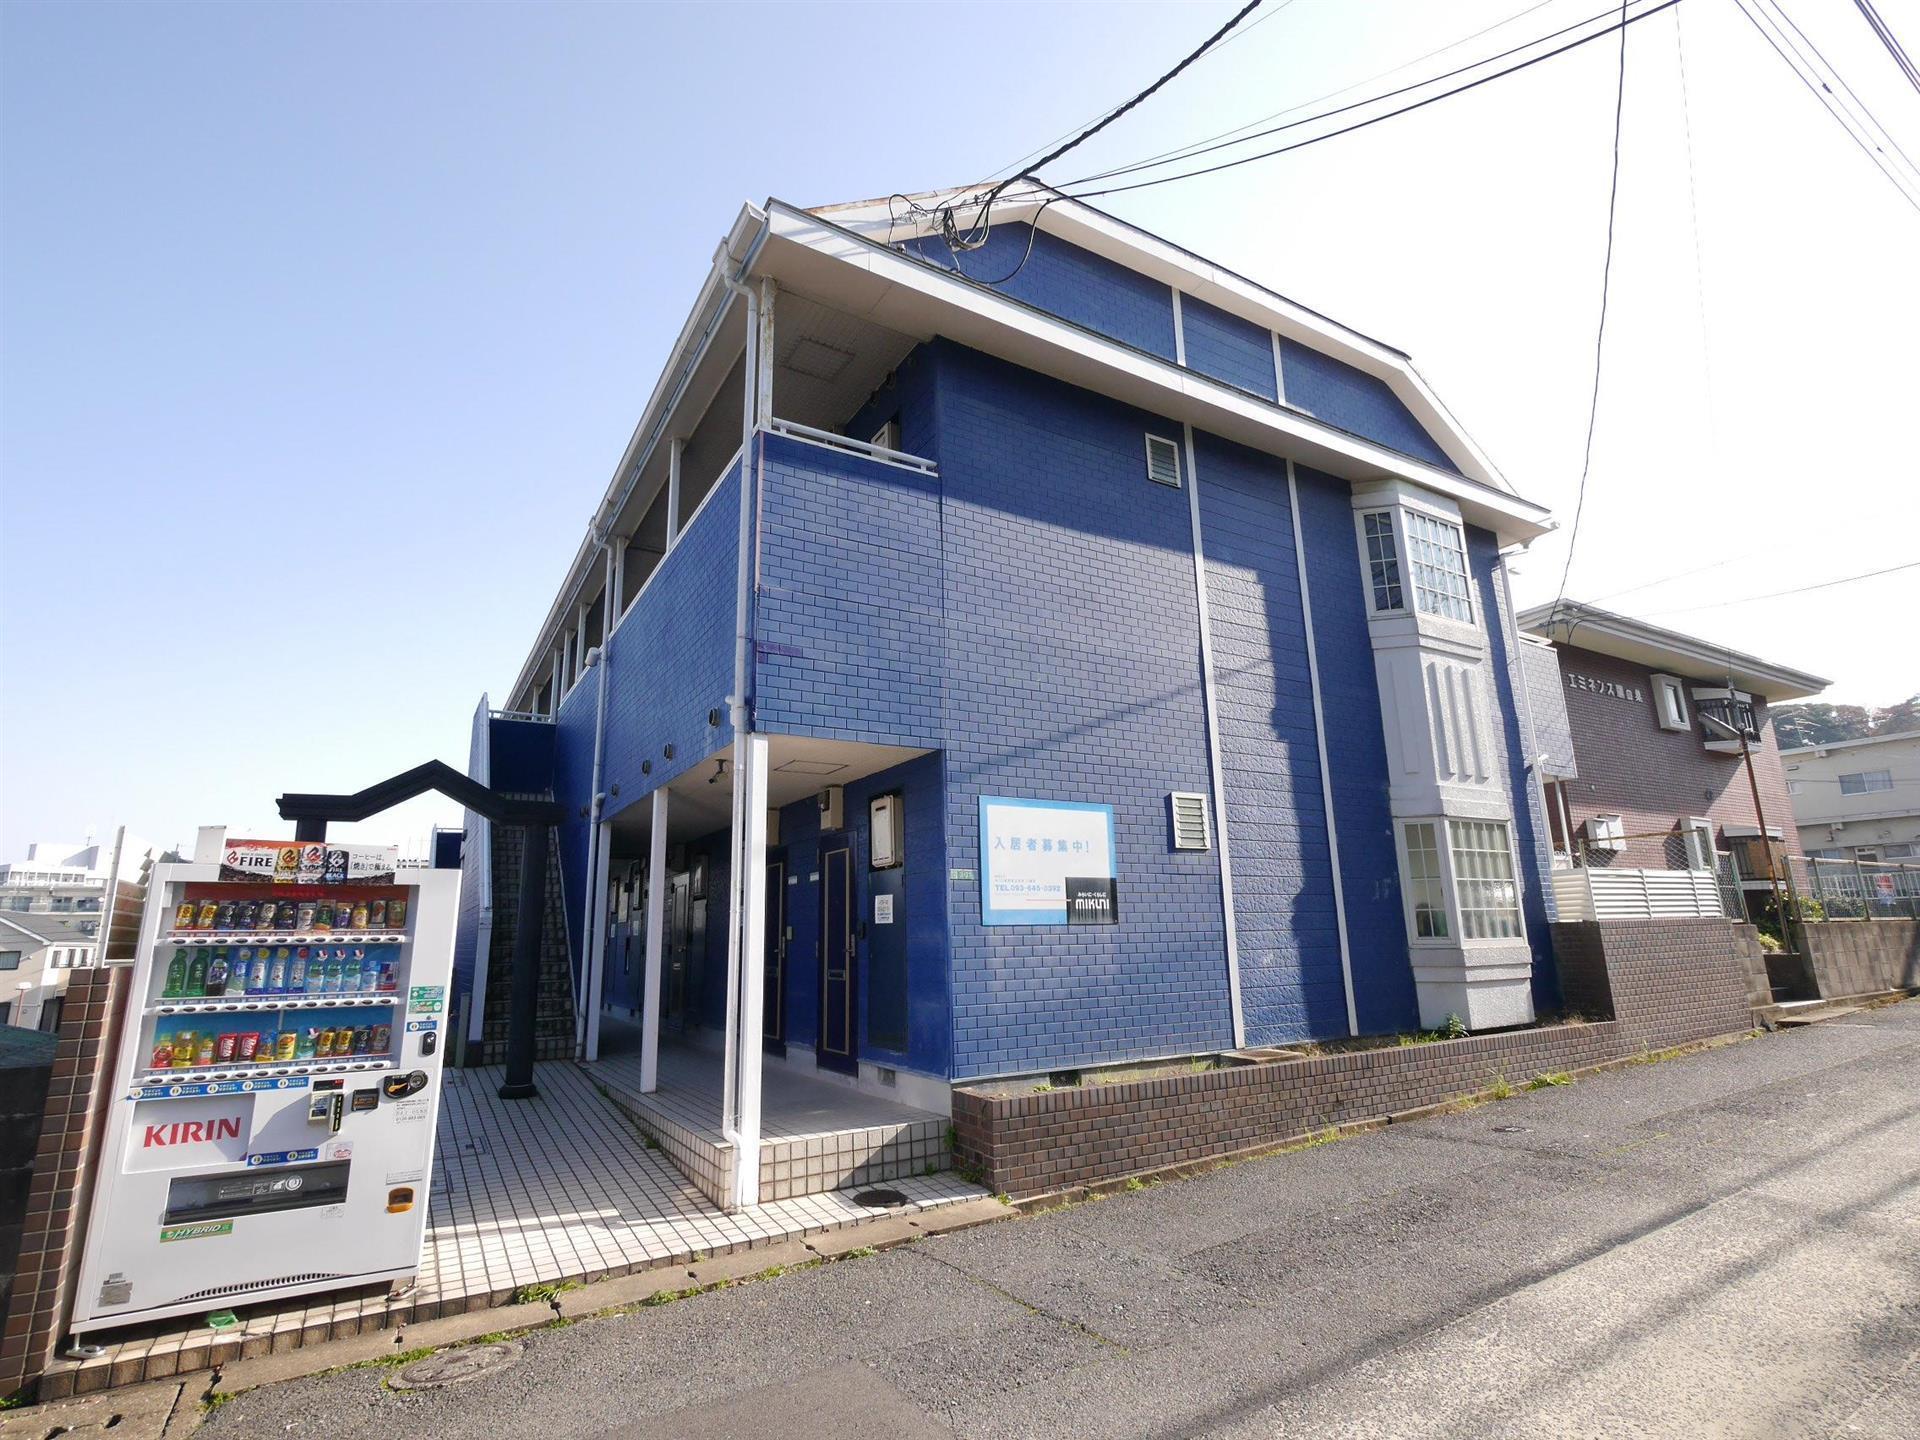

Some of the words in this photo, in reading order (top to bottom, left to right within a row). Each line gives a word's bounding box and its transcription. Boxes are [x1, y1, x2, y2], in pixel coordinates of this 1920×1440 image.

[1567, 673, 1644, 703] エミネンスの巣
[240, 857, 273, 867] FIRE
[144, 1117, 241, 1148] KIRIN
[173, 1224, 221, 1239] HYBRID
